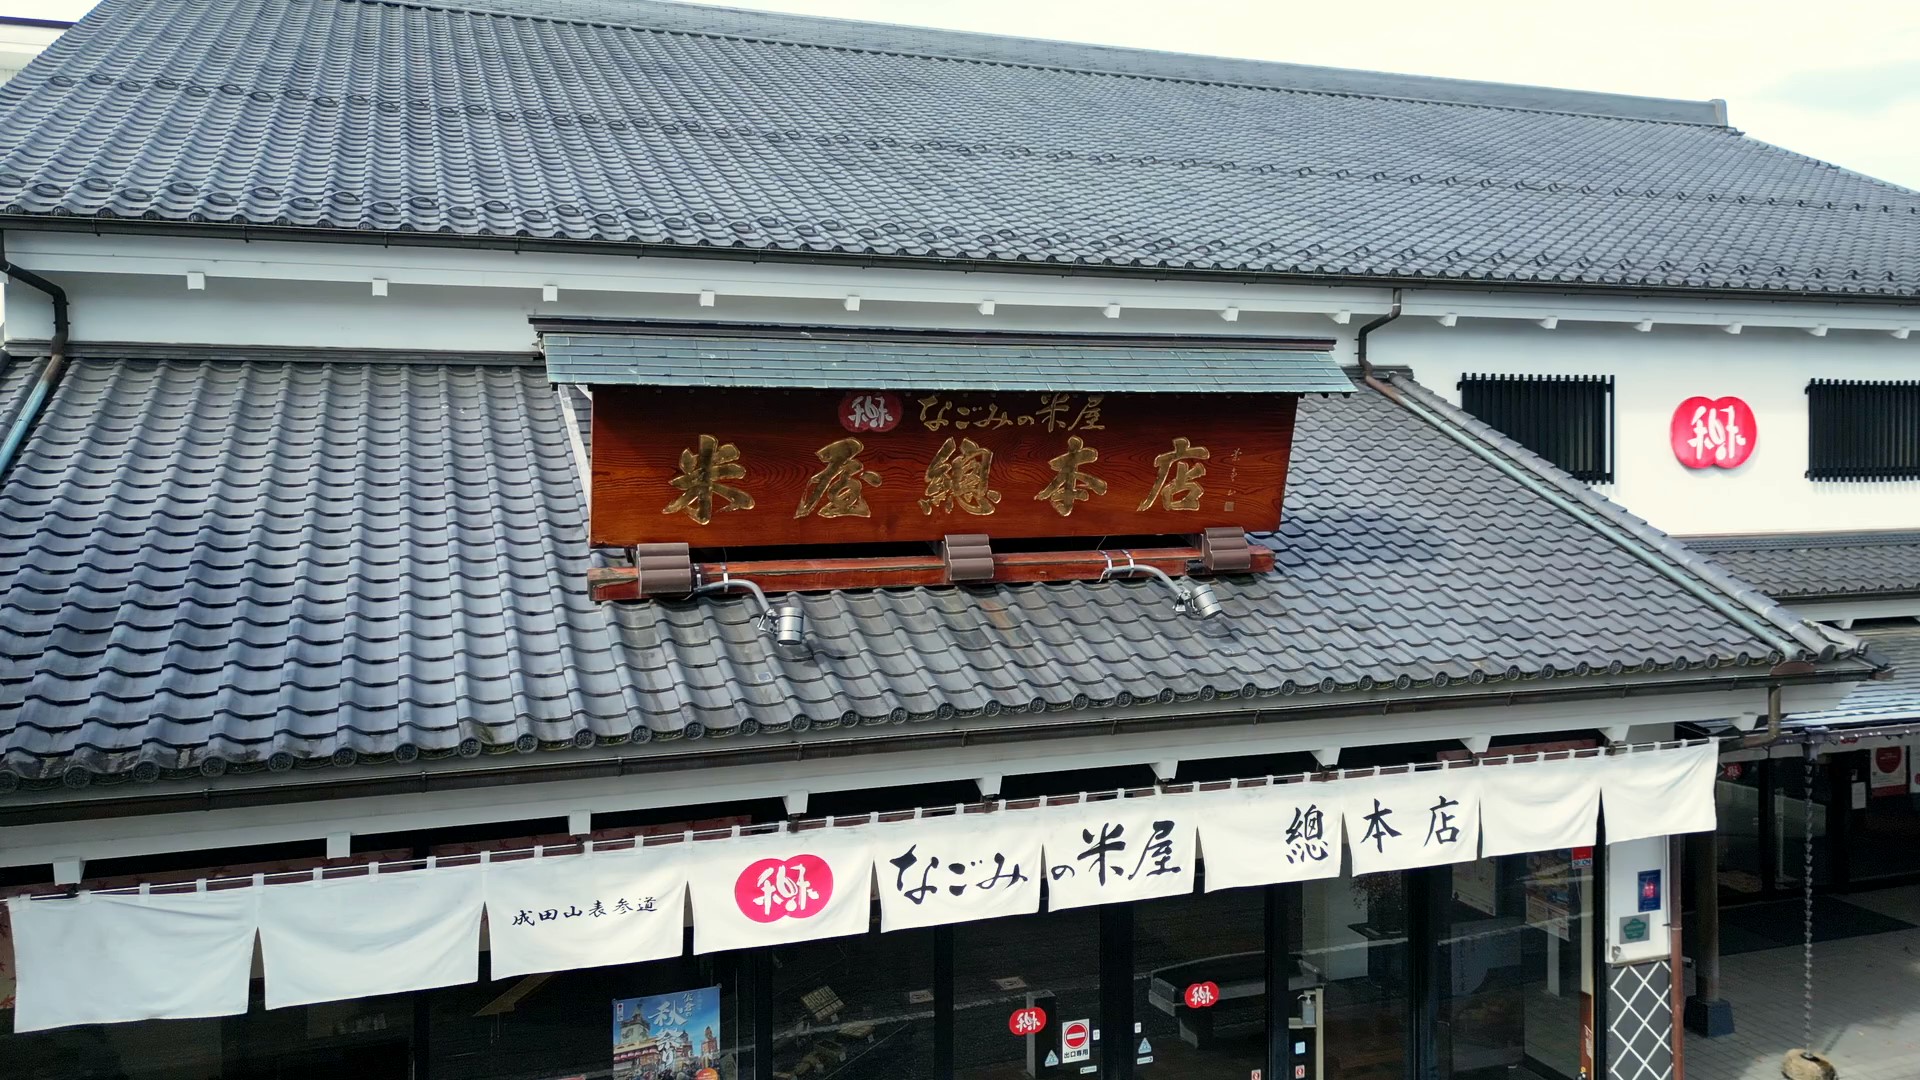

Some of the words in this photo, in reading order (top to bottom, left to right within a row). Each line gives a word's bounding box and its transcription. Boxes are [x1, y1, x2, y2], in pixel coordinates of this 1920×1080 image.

[918, 393, 1105, 433] なごみの米屋
[890, 820, 1181, 905] なごみの米屋
[512, 897, 658, 926] 成田山表参道
